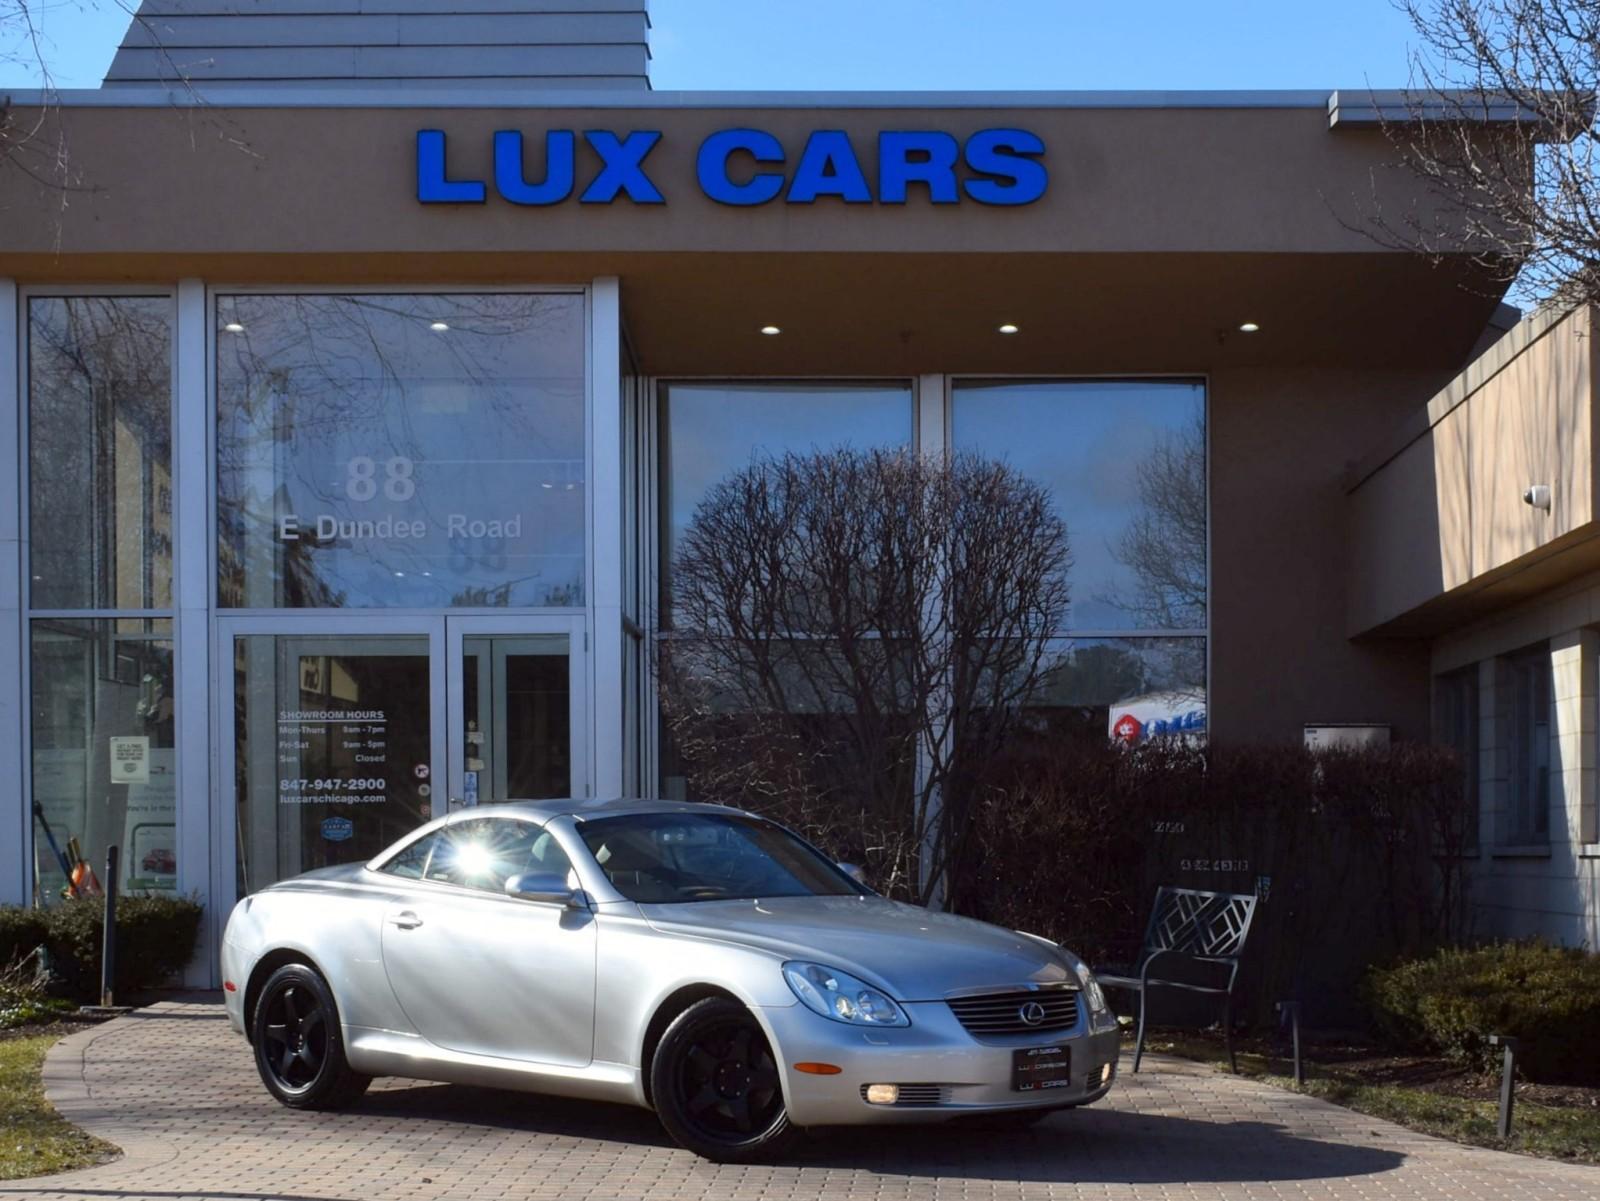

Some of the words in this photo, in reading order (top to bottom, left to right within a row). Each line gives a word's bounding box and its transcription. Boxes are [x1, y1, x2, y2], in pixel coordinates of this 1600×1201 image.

[416, 128, 667, 206] LUX
[696, 128, 1049, 207] CARS
[346, 456, 416, 502] 88
[280, 515, 300, 540] E
[316, 515, 427, 540] Dundee
[448, 514, 522, 538] Road
[280, 710, 344, 720] SHOWROOM
[346, 710, 385, 719] HOURS
[355, 754, 385, 762] Closed
[280, 778, 386, 790] 847-947-2900
[280, 794, 386, 805] luxcarschicago.com
